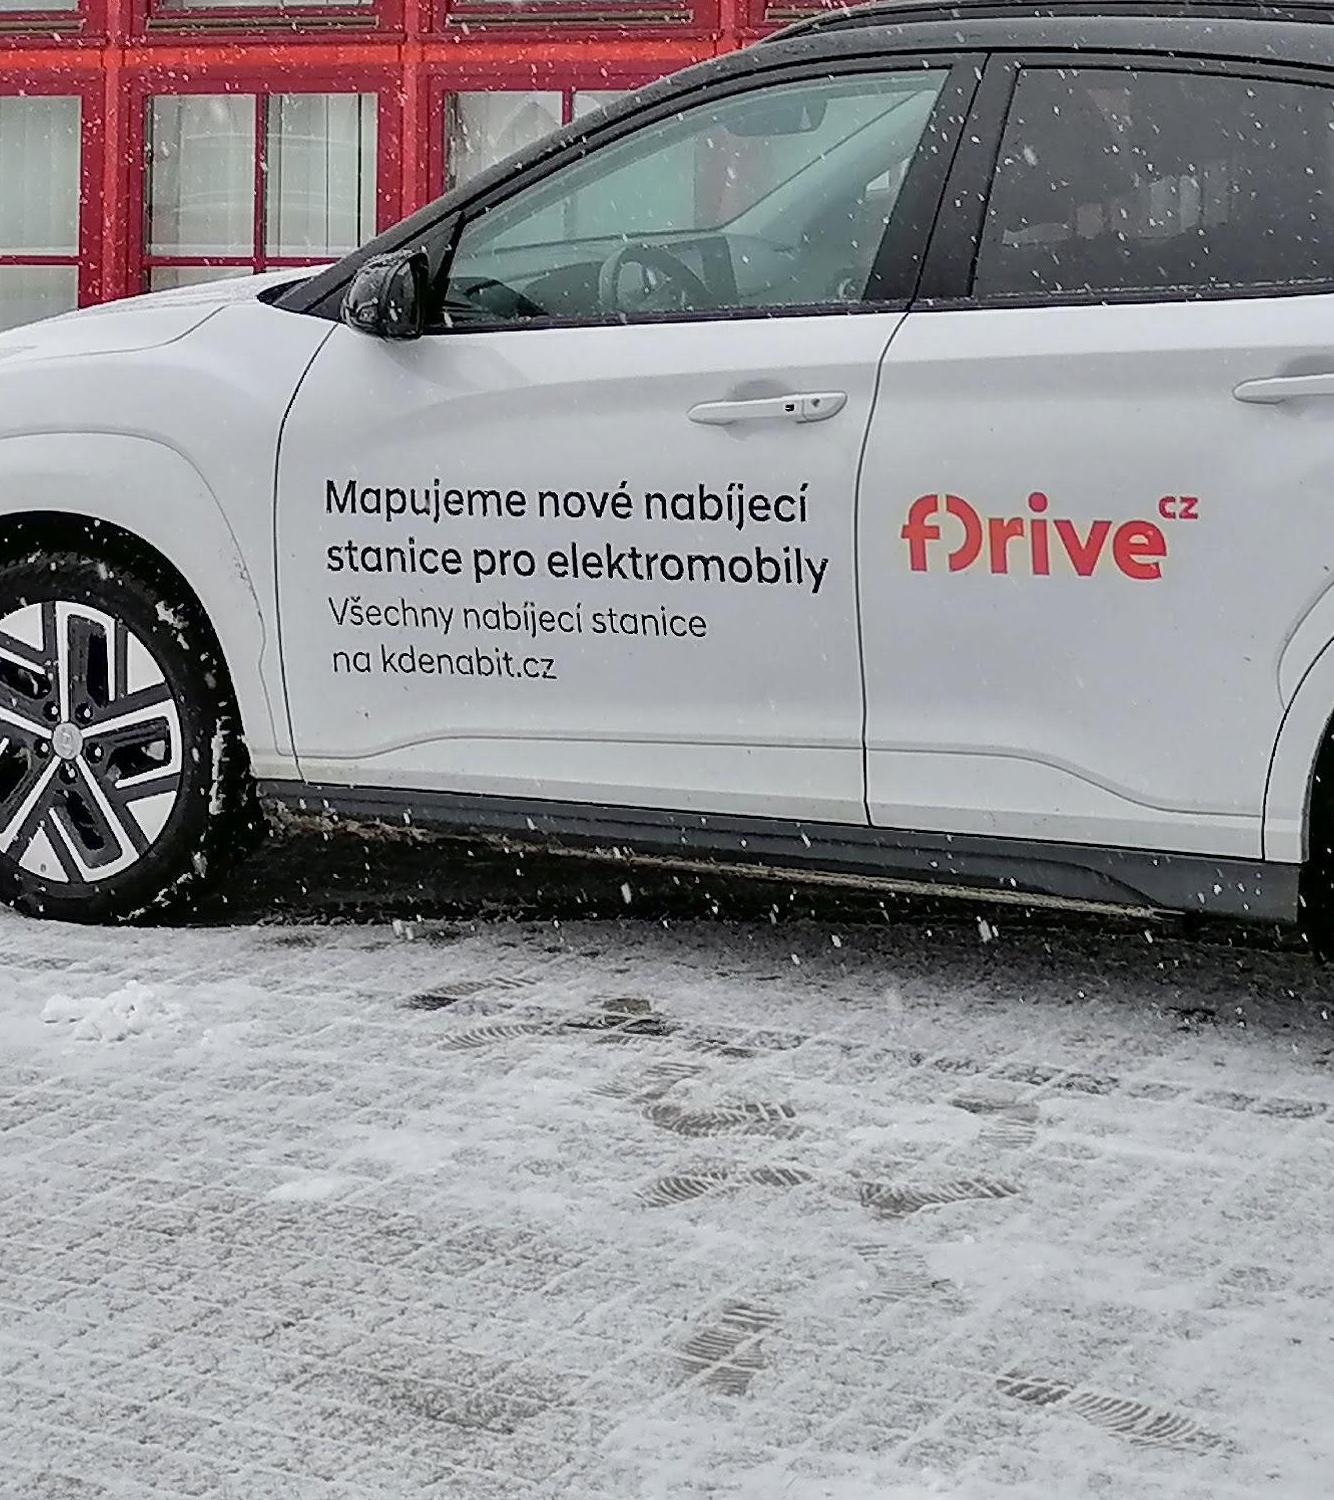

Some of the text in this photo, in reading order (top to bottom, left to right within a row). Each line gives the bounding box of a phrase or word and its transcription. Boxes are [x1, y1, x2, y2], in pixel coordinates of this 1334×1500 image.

[325, 478, 809, 531] Mapujeme nové nabíjecí
[326, 536, 830, 594] stanice pro elektromobily
[327, 596, 708, 639] Všechny nabíjecí stanice
[332, 644, 559, 680] na kdenabit.cz
